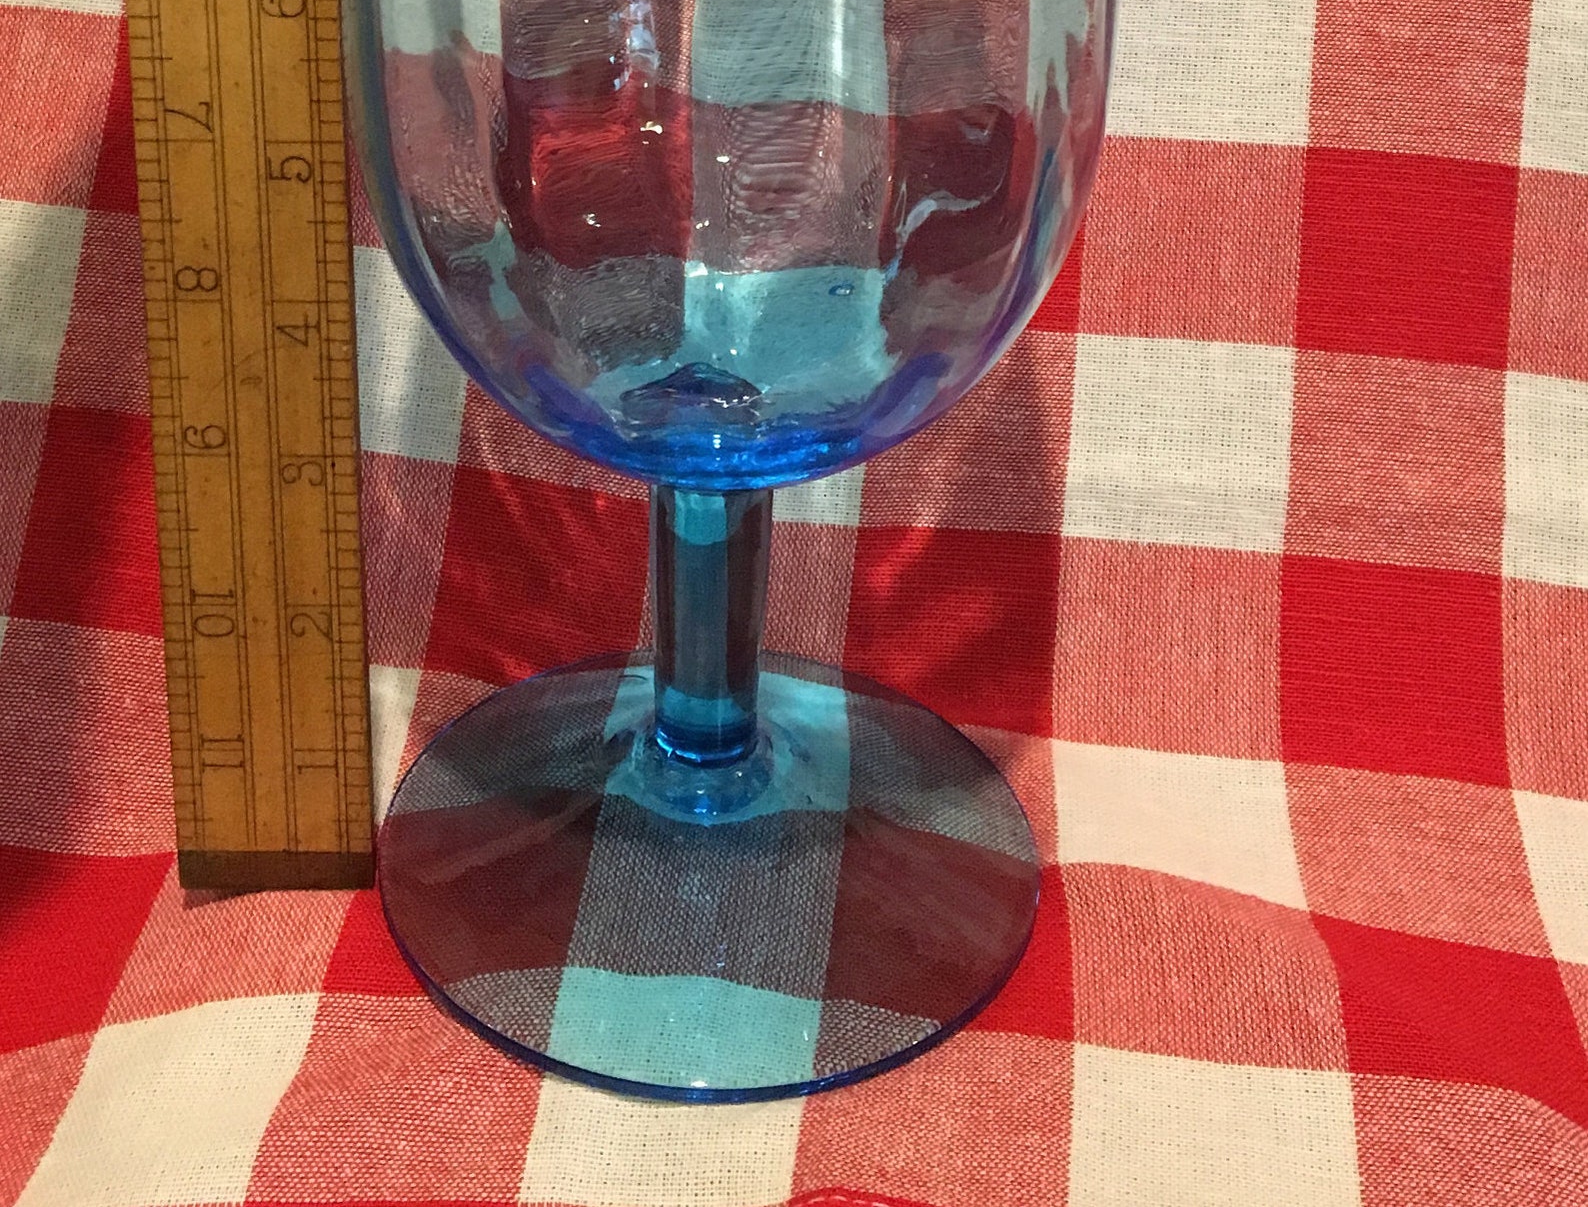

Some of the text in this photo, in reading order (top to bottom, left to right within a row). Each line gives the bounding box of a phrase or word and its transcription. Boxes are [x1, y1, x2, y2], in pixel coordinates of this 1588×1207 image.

[164, 100, 214, 135] 7
[266, 154, 314, 184] 5
[175, 265, 219, 293] 8
[275, 311, 321, 347] 4
[183, 423, 227, 451] 9
[282, 458, 325, 487] 3
[190, 587, 236, 640] 10
[290, 610, 334, 641] 2
[201, 733, 245, 773] 11
